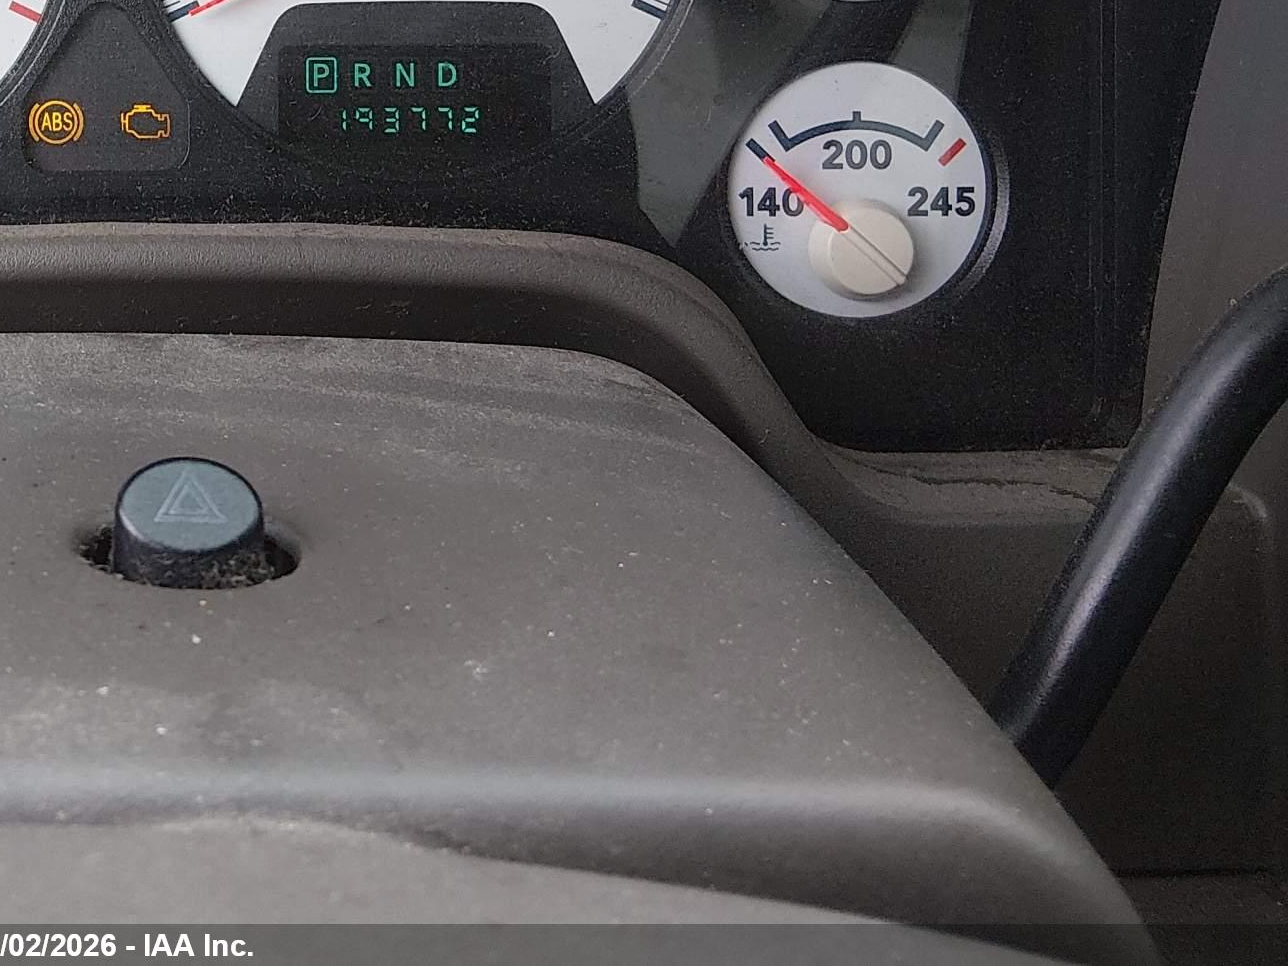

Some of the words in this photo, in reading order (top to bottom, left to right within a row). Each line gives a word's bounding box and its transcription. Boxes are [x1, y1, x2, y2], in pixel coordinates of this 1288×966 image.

[313, 63, 330, 87] P
[354, 63, 372, 87] R
[395, 62, 415, 87] N
[438, 62, 457, 87] D
[40, 111, 74, 132] ABS
[342, 107, 479, 133] 193772
[821, 139, 893, 170] 200
[738, 186, 804, 218] 140
[907, 186, 976, 217] 245
